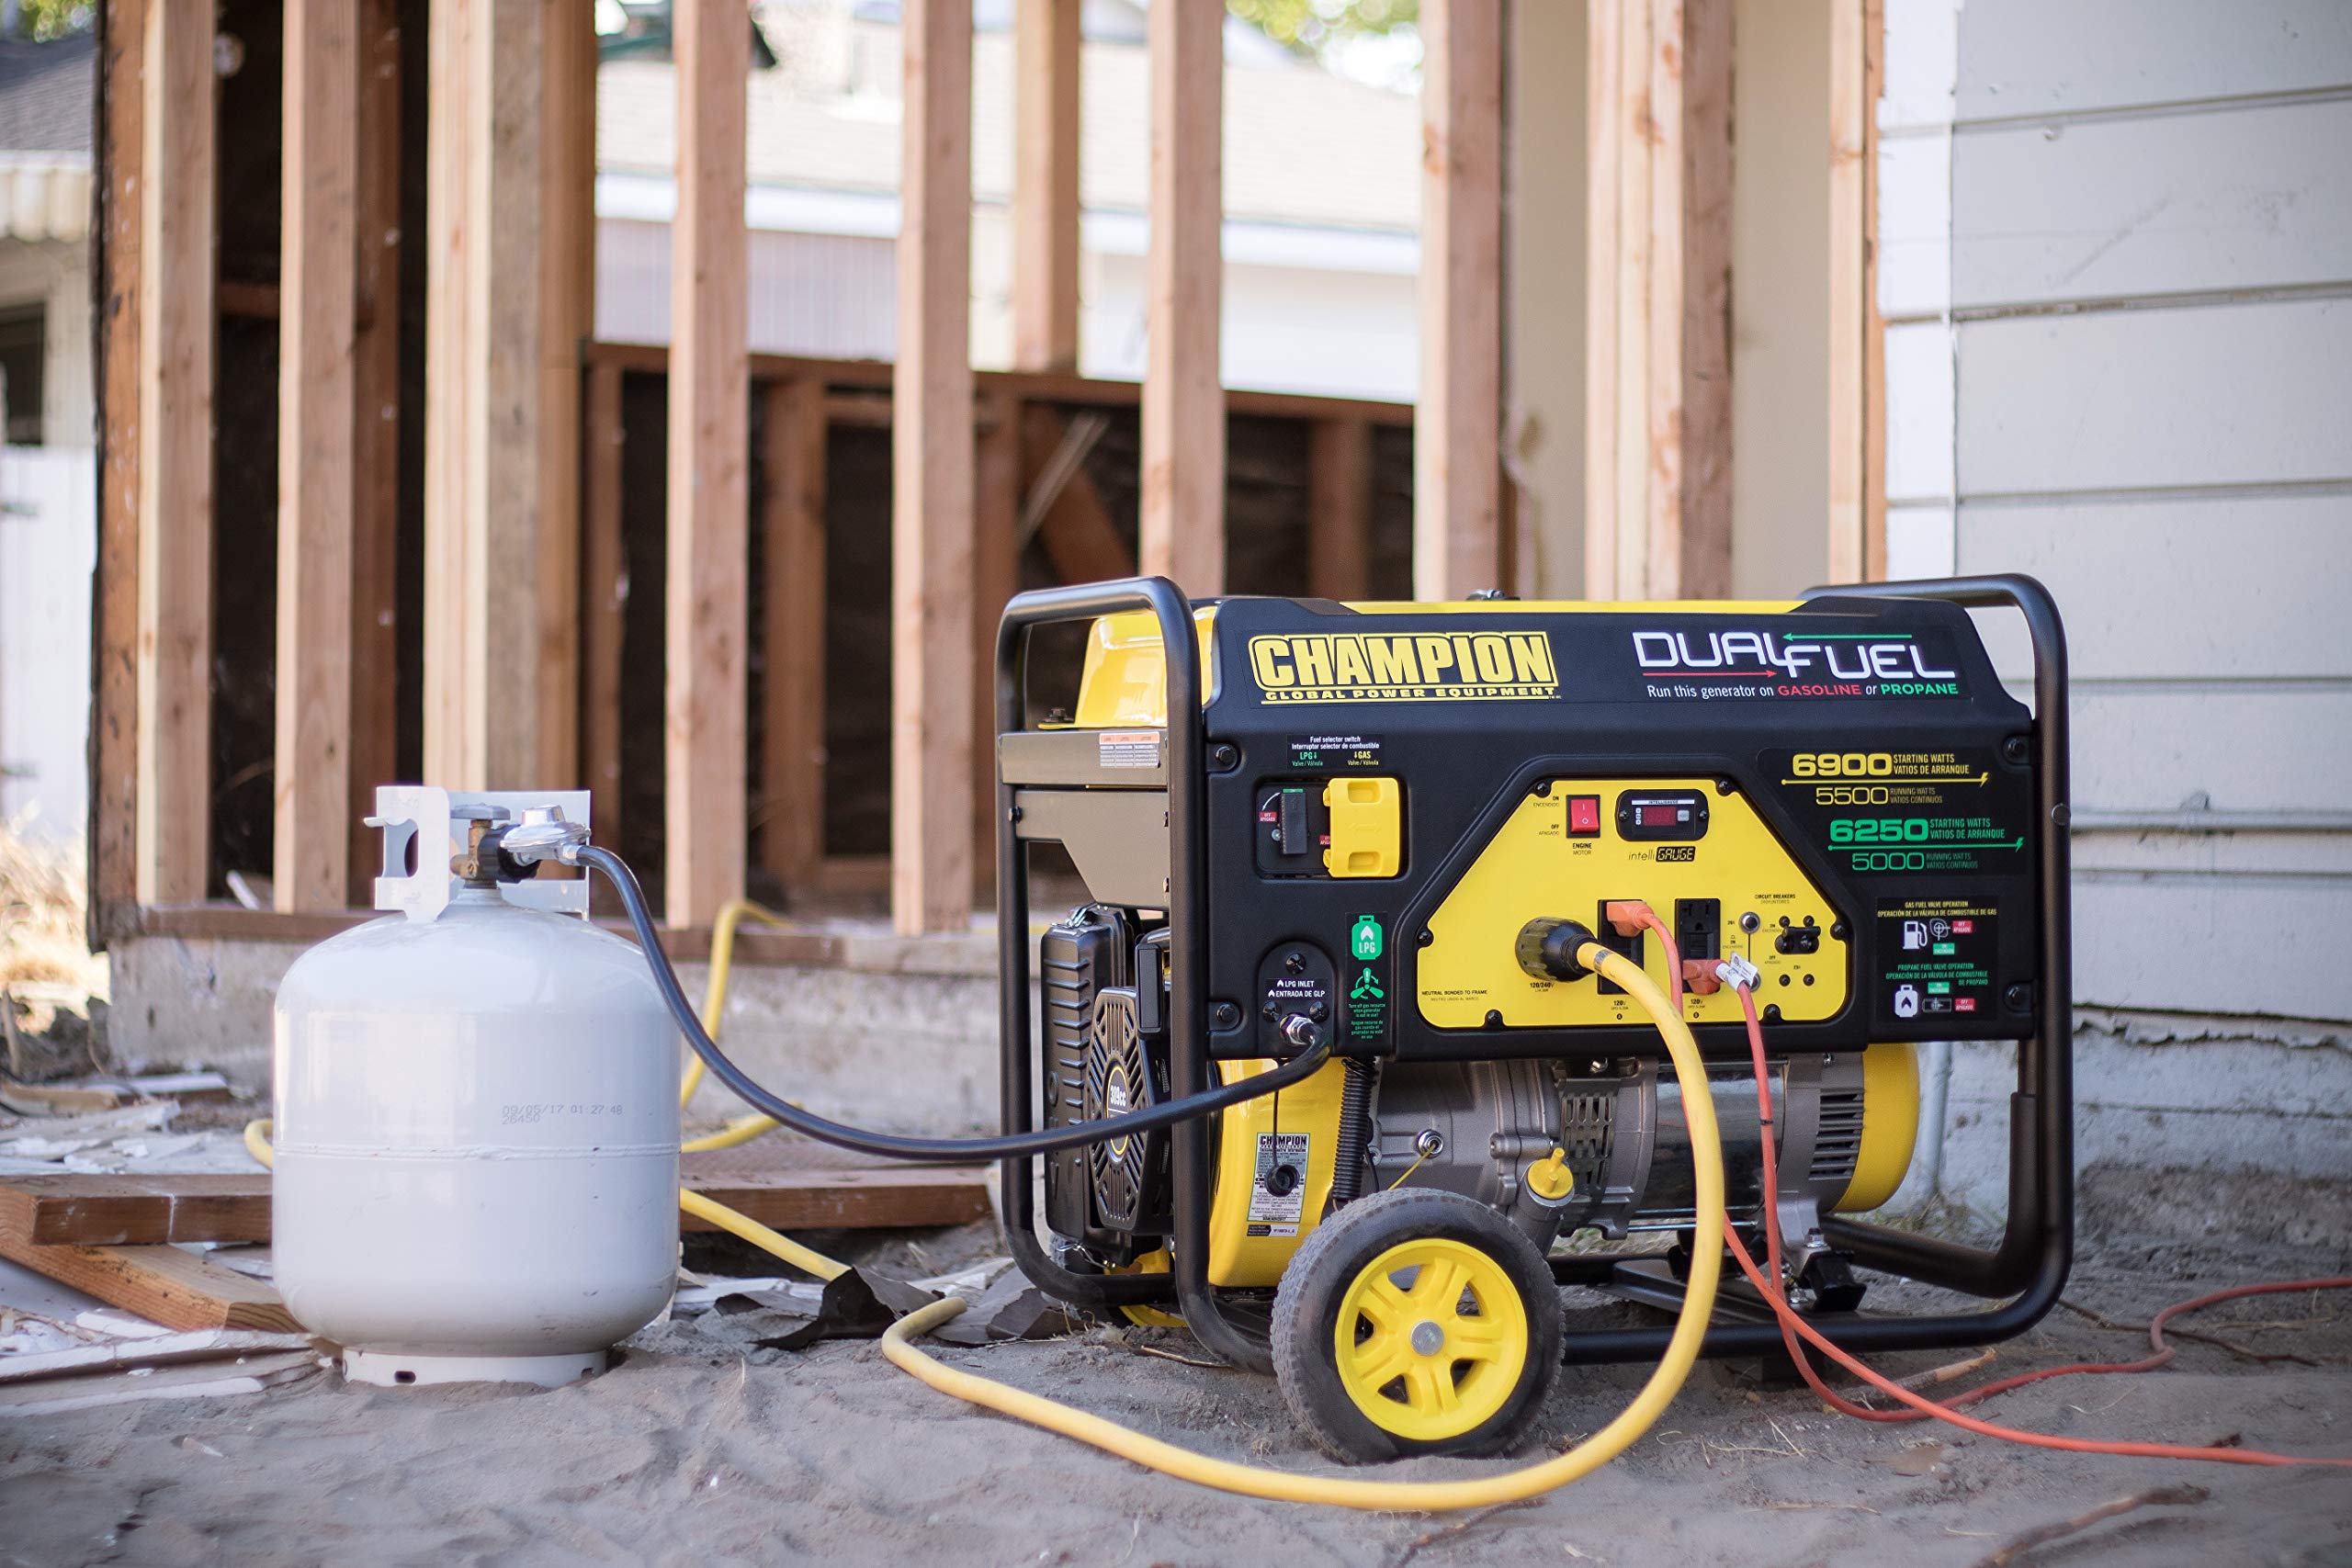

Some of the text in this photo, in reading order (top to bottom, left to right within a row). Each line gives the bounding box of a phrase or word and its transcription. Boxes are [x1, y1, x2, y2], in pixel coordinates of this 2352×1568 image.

[1250, 633, 1556, 687] CHAMPION
[1632, 631, 1956, 679] DUAL FUEL
[1264, 691, 1346, 701] GLOBAL
[1352, 689, 1425, 699] POWER
[1434, 686, 1555, 697] EQUIPMENT
[1647, 683, 1958, 700] Run this generator on GASOLINE or PROPANE
[1793, 753, 1955, 776] 6900 STARTING WATTS
[1894, 764, 1970, 774] VATIOS DE ARRANQUE
[1816, 787, 1888, 805] 5500
[1910, 795, 1943, 804] CONTINUOS
[1830, 818, 1991, 842] 6250 STARTING WATTS
[1930, 829, 2005, 839] VATIOS DE ARRANQUE
[1852, 852, 1925, 870] 5000
[1359, 942, 1375, 954] LPG
